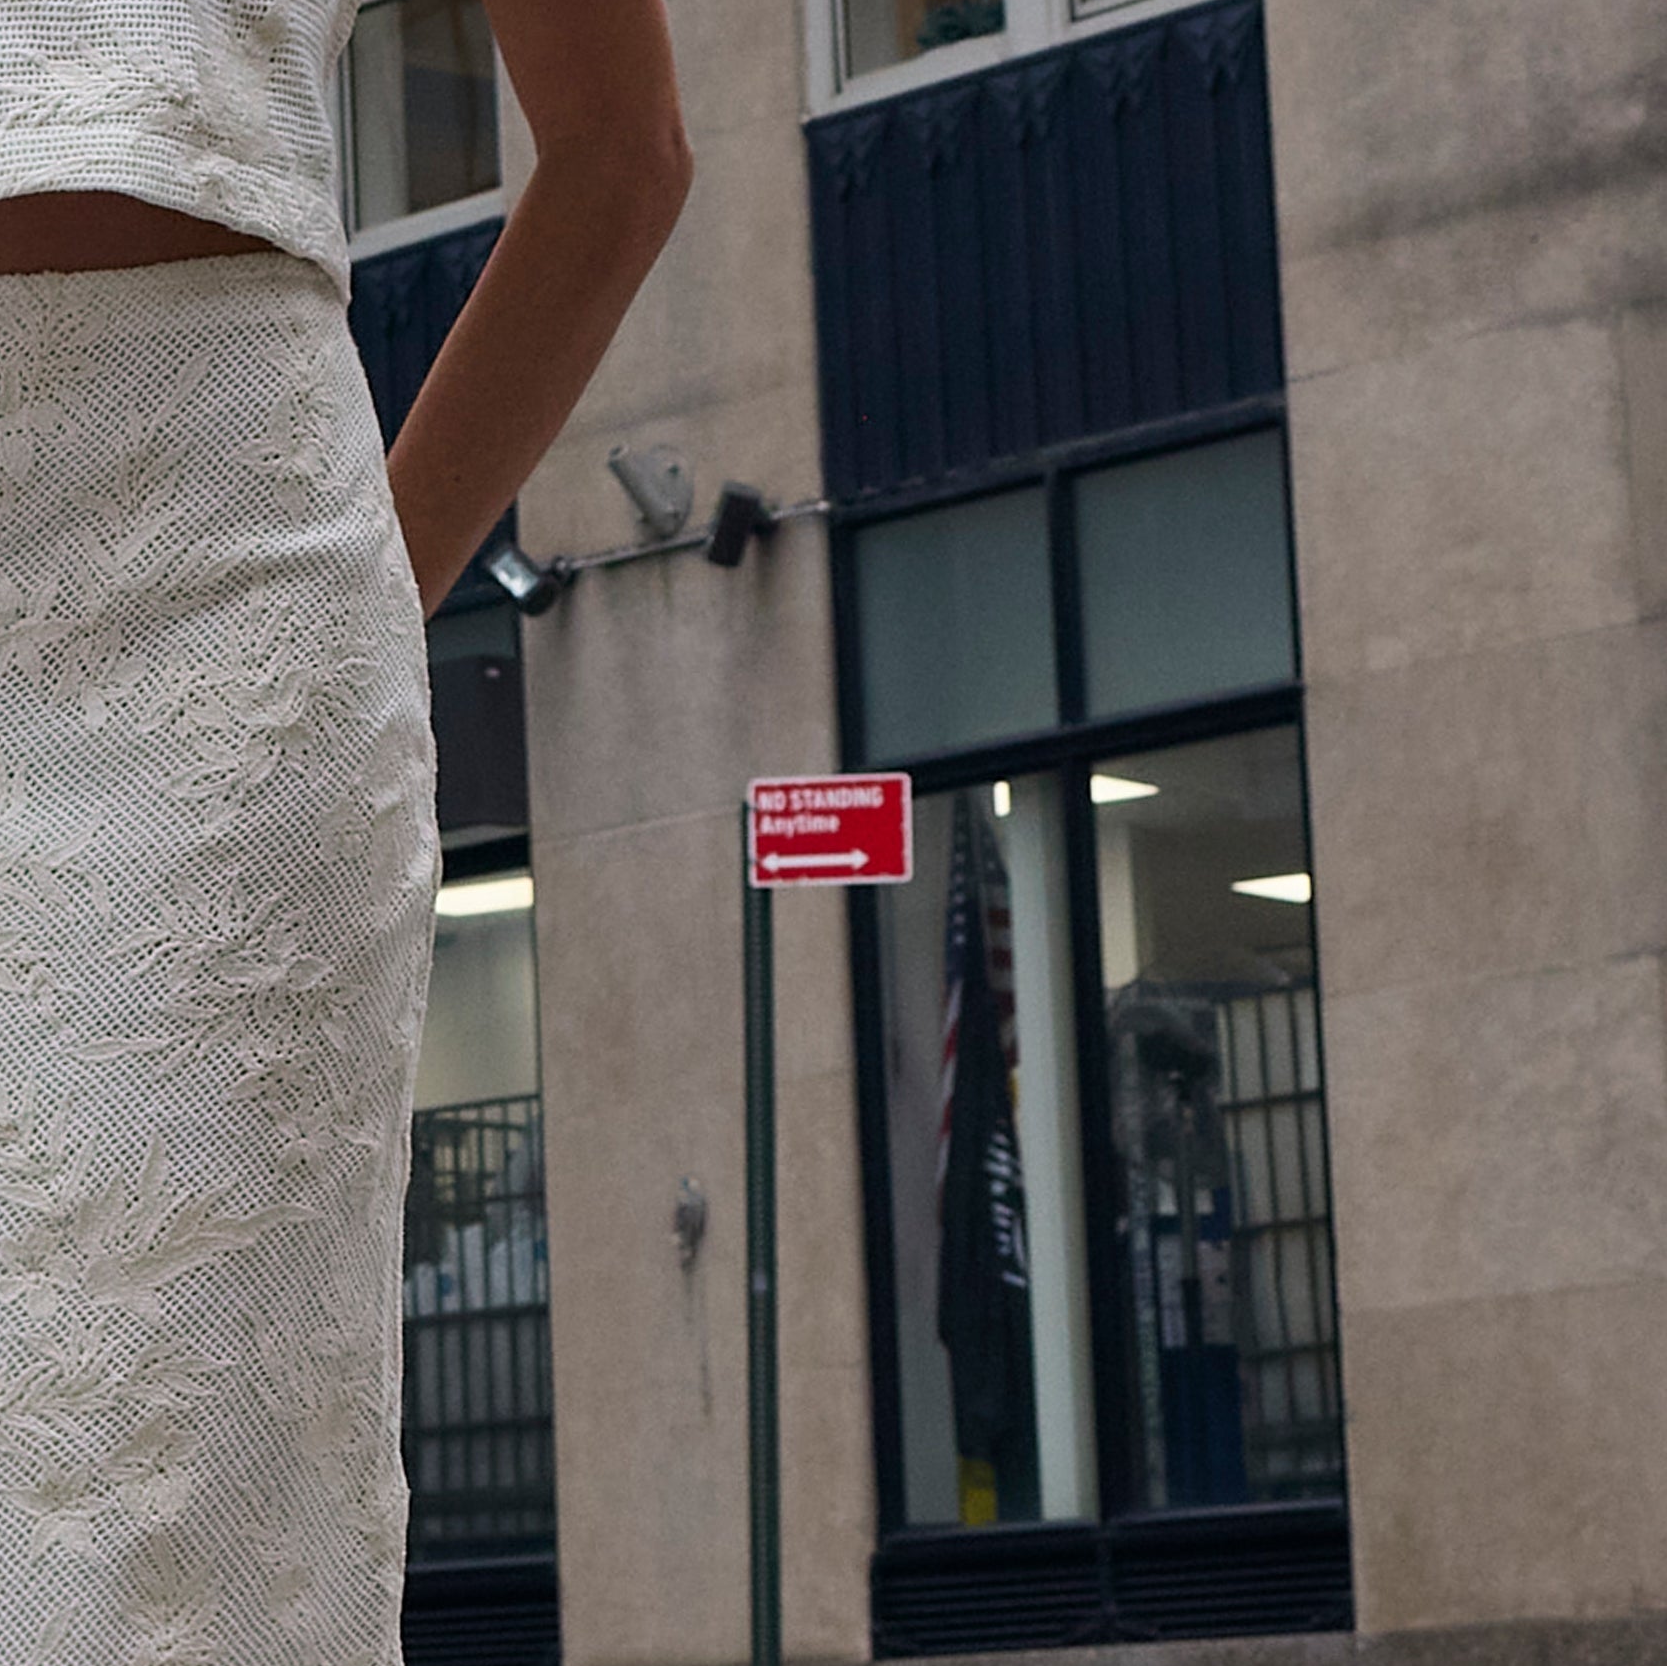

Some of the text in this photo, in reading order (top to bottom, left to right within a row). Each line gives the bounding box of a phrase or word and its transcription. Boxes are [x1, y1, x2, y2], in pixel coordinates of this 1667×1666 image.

[759, 787, 884, 811] NO STANDING
[761, 815, 840, 837] Anytime
